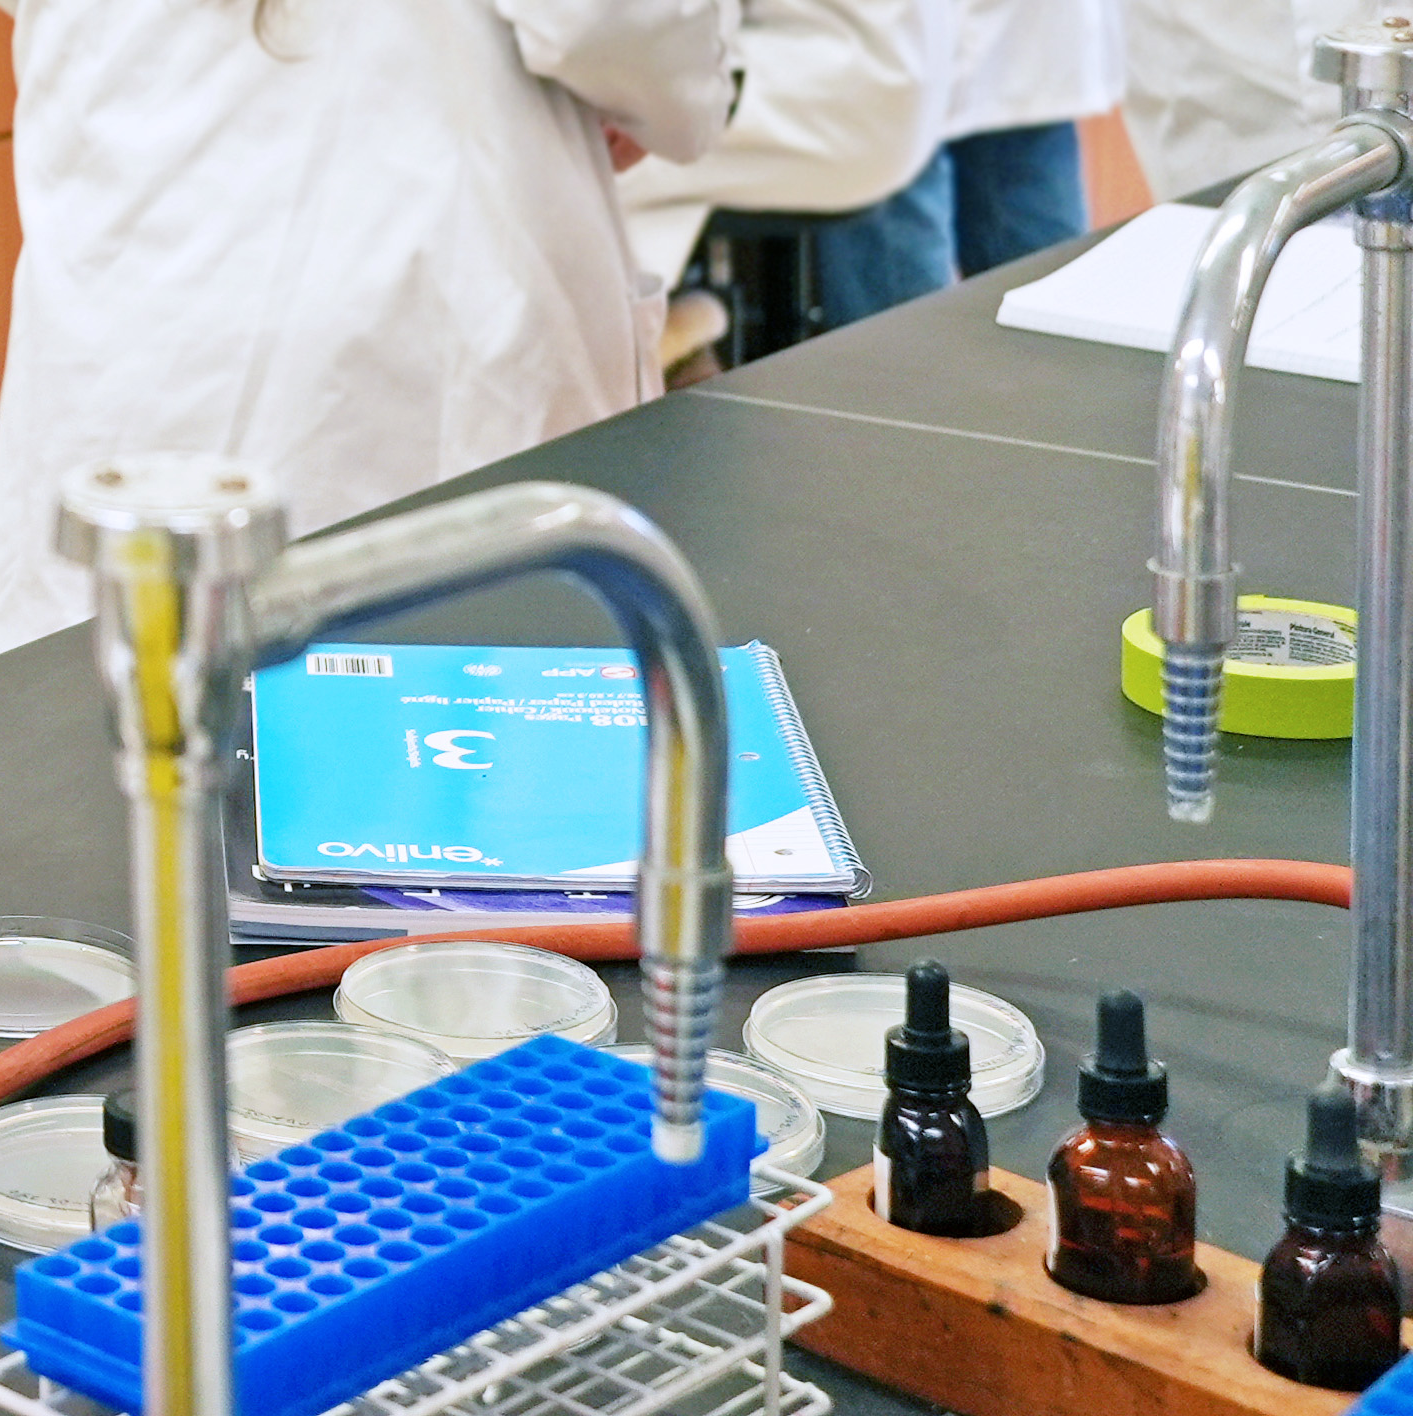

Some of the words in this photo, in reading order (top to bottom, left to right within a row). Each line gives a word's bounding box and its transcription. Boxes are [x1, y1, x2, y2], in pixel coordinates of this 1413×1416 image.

[541, 667, 596, 678] APP
[452, 696, 515, 706] Papier
[527, 697, 585, 707] Paper
[475, 705, 536, 714] Cahier
[550, 707, 646, 715] Notebook
[523, 713, 582, 722] Pages
[423, 729, 496, 770] 3
[317, 841, 483, 864] enlivo
